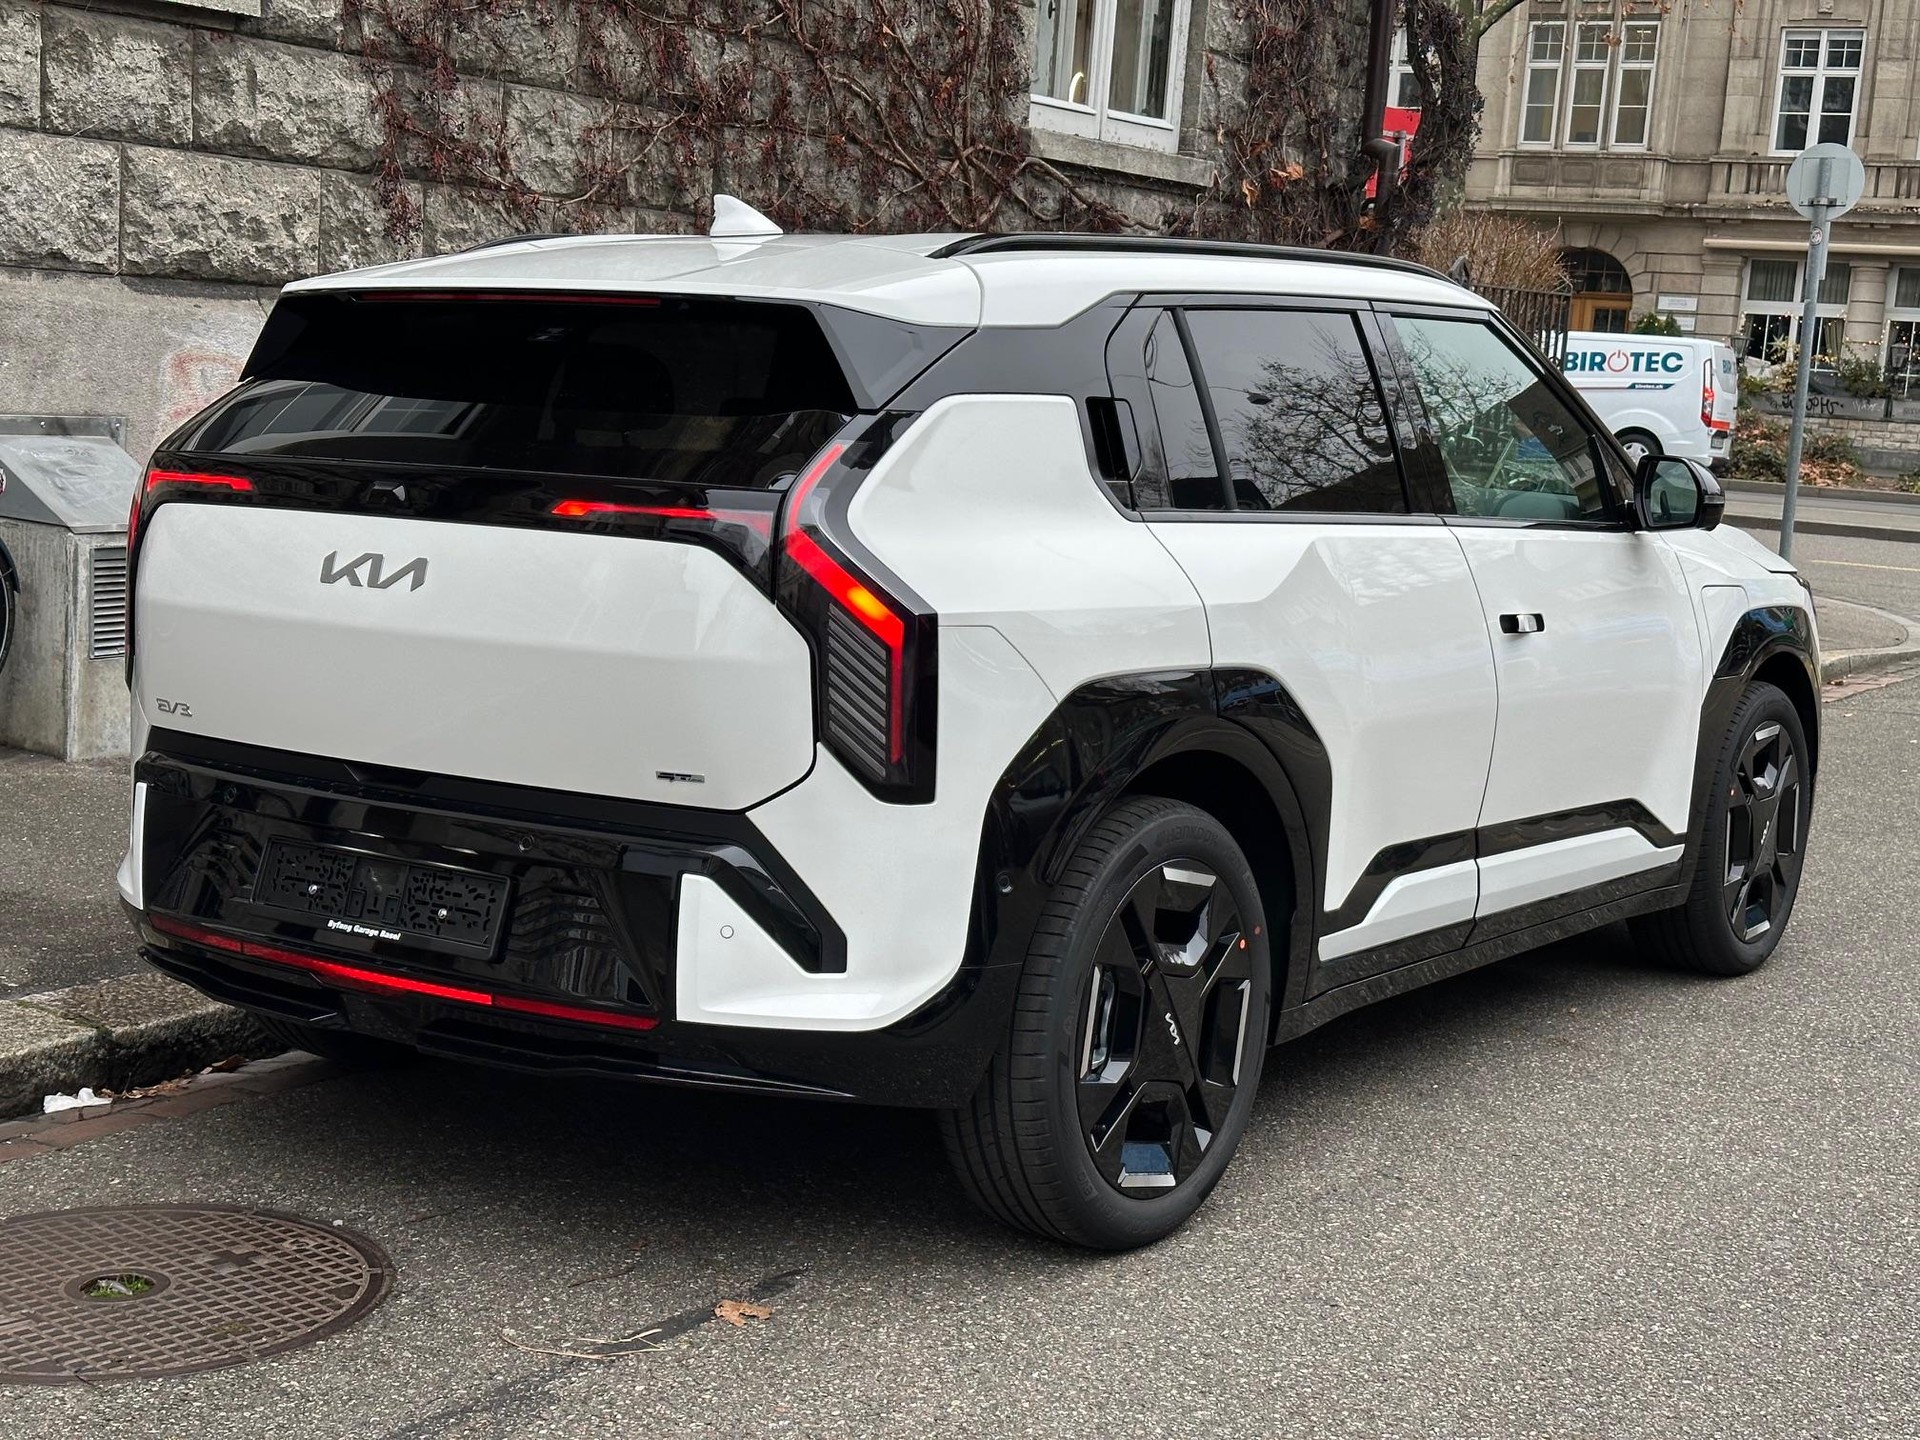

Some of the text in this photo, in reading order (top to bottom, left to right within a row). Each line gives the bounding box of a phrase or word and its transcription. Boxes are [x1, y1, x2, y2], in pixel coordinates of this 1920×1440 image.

[1564, 350, 1684, 373] BIROTEC
[320, 550, 428, 592] KIA
[156, 697, 193, 718] EV3
[353, 924, 380, 938] Garage
[379, 929, 402, 941] Basel
